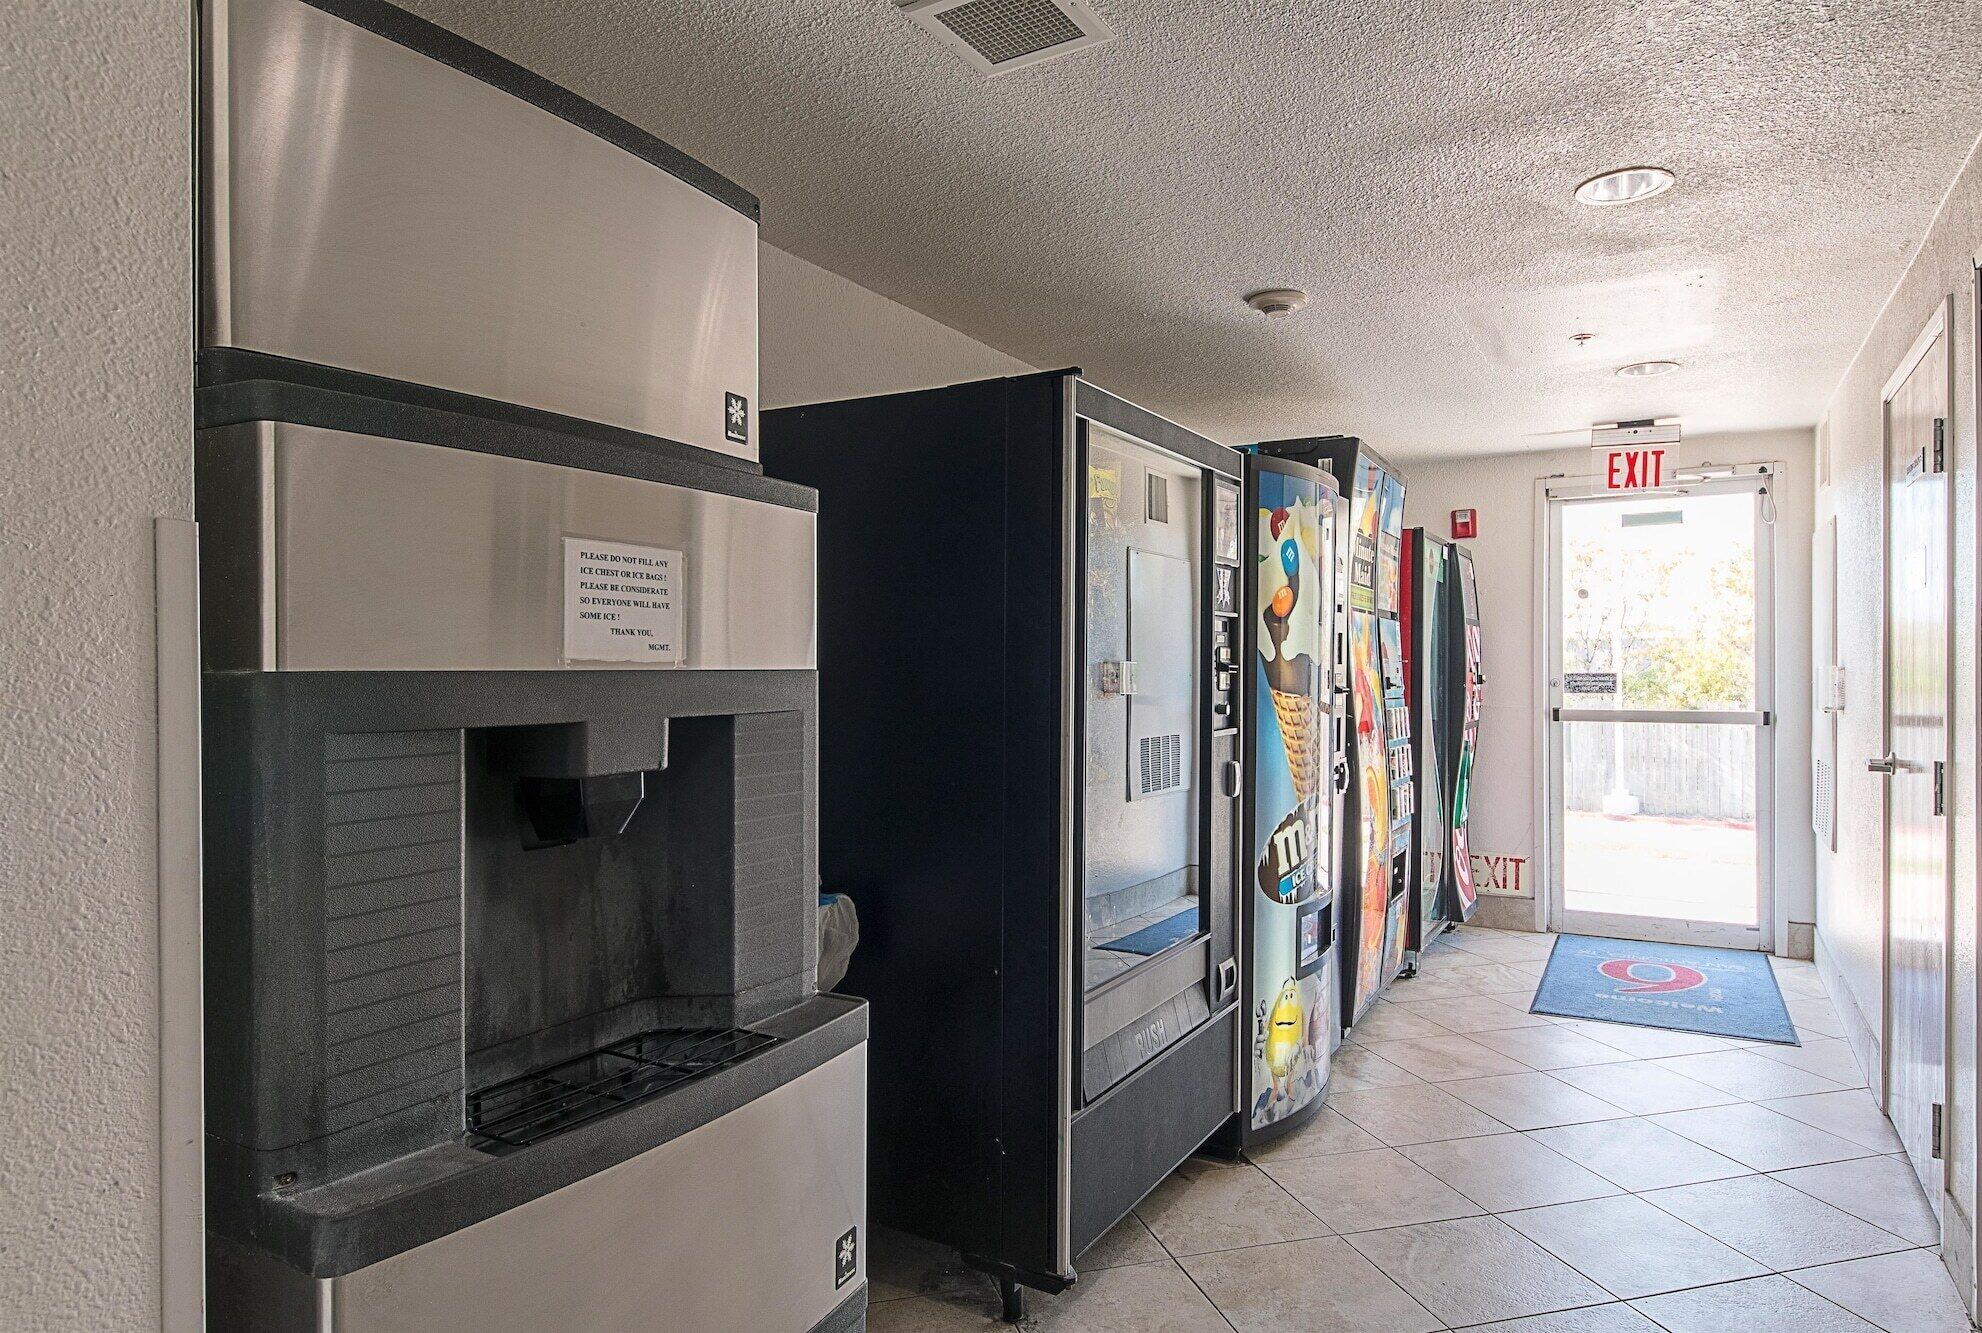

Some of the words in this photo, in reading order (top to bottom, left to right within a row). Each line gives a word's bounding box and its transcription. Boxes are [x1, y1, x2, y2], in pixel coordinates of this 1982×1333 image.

[1608, 450, 1665, 489] EXIT
[580, 551, 608, 561] PLEASE
[610, 554, 621, 563] DO
[622, 556, 637, 564] NOT
[638, 558, 653, 567] FILL
[655, 560, 669, 568] ANY
[580, 566, 593, 575] ICE
[595, 567, 619, 578] CHEST
[621, 570, 632, 579] OR
[632, 571, 645, 580] ICE
[580, 581, 608, 591] PLEASE
[610, 583, 620, 592] BE
[621, 584, 669, 596] CONSIDERATE
[592, 597, 632, 607] EVERYONE
[633, 600, 651, 609] WILL
[652, 602, 670, 610] HAVE
[579, 611, 602, 620] SOME
[610, 627, 636, 636] THANK
[637, 629, 653, 637] YOU,
[648, 643, 671, 652] MGMT.
[1292, 869, 1306, 888] ICE
[1595, 992, 1724, 1014] Welcome
[1135, 1018, 1168, 1060] PUSH
